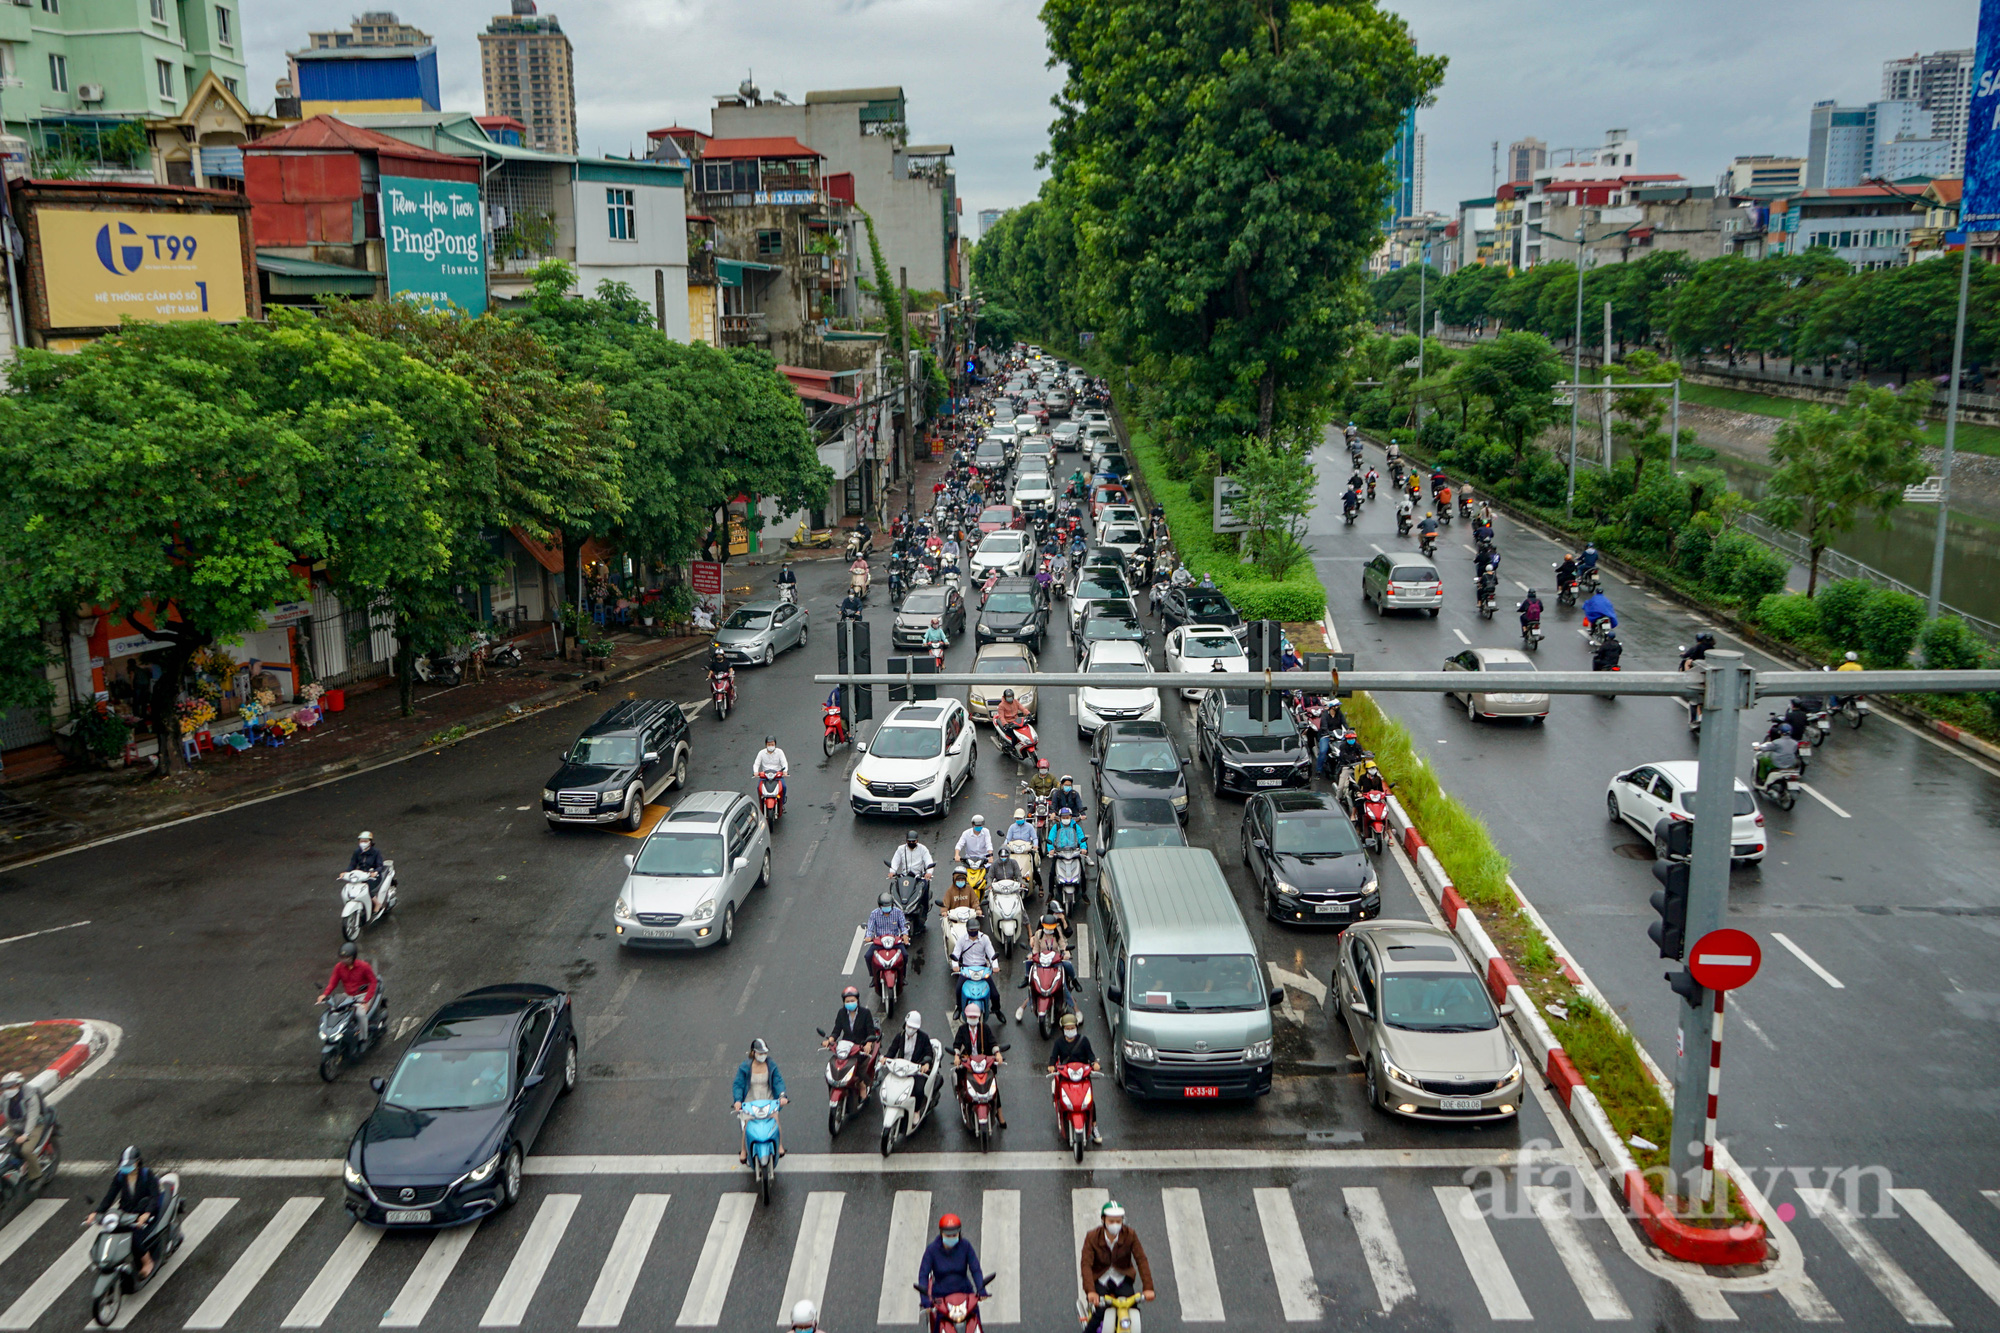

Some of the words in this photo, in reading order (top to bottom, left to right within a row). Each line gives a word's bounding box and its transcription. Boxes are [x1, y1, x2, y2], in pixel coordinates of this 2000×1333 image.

[388, 188, 417, 216] Tiệm
[419, 190, 448, 223] Hoa
[145, 234, 198, 261] T99
[391, 225, 479, 262] PingPong
[441, 264, 478, 275] Flowers
[95, 292, 109, 304] HỆ
[110, 289, 145, 302] THỐNG
[185, 289, 198, 301] SỐ
[156, 304, 177, 315] VIỆT
[178, 305, 199, 314] NAM
